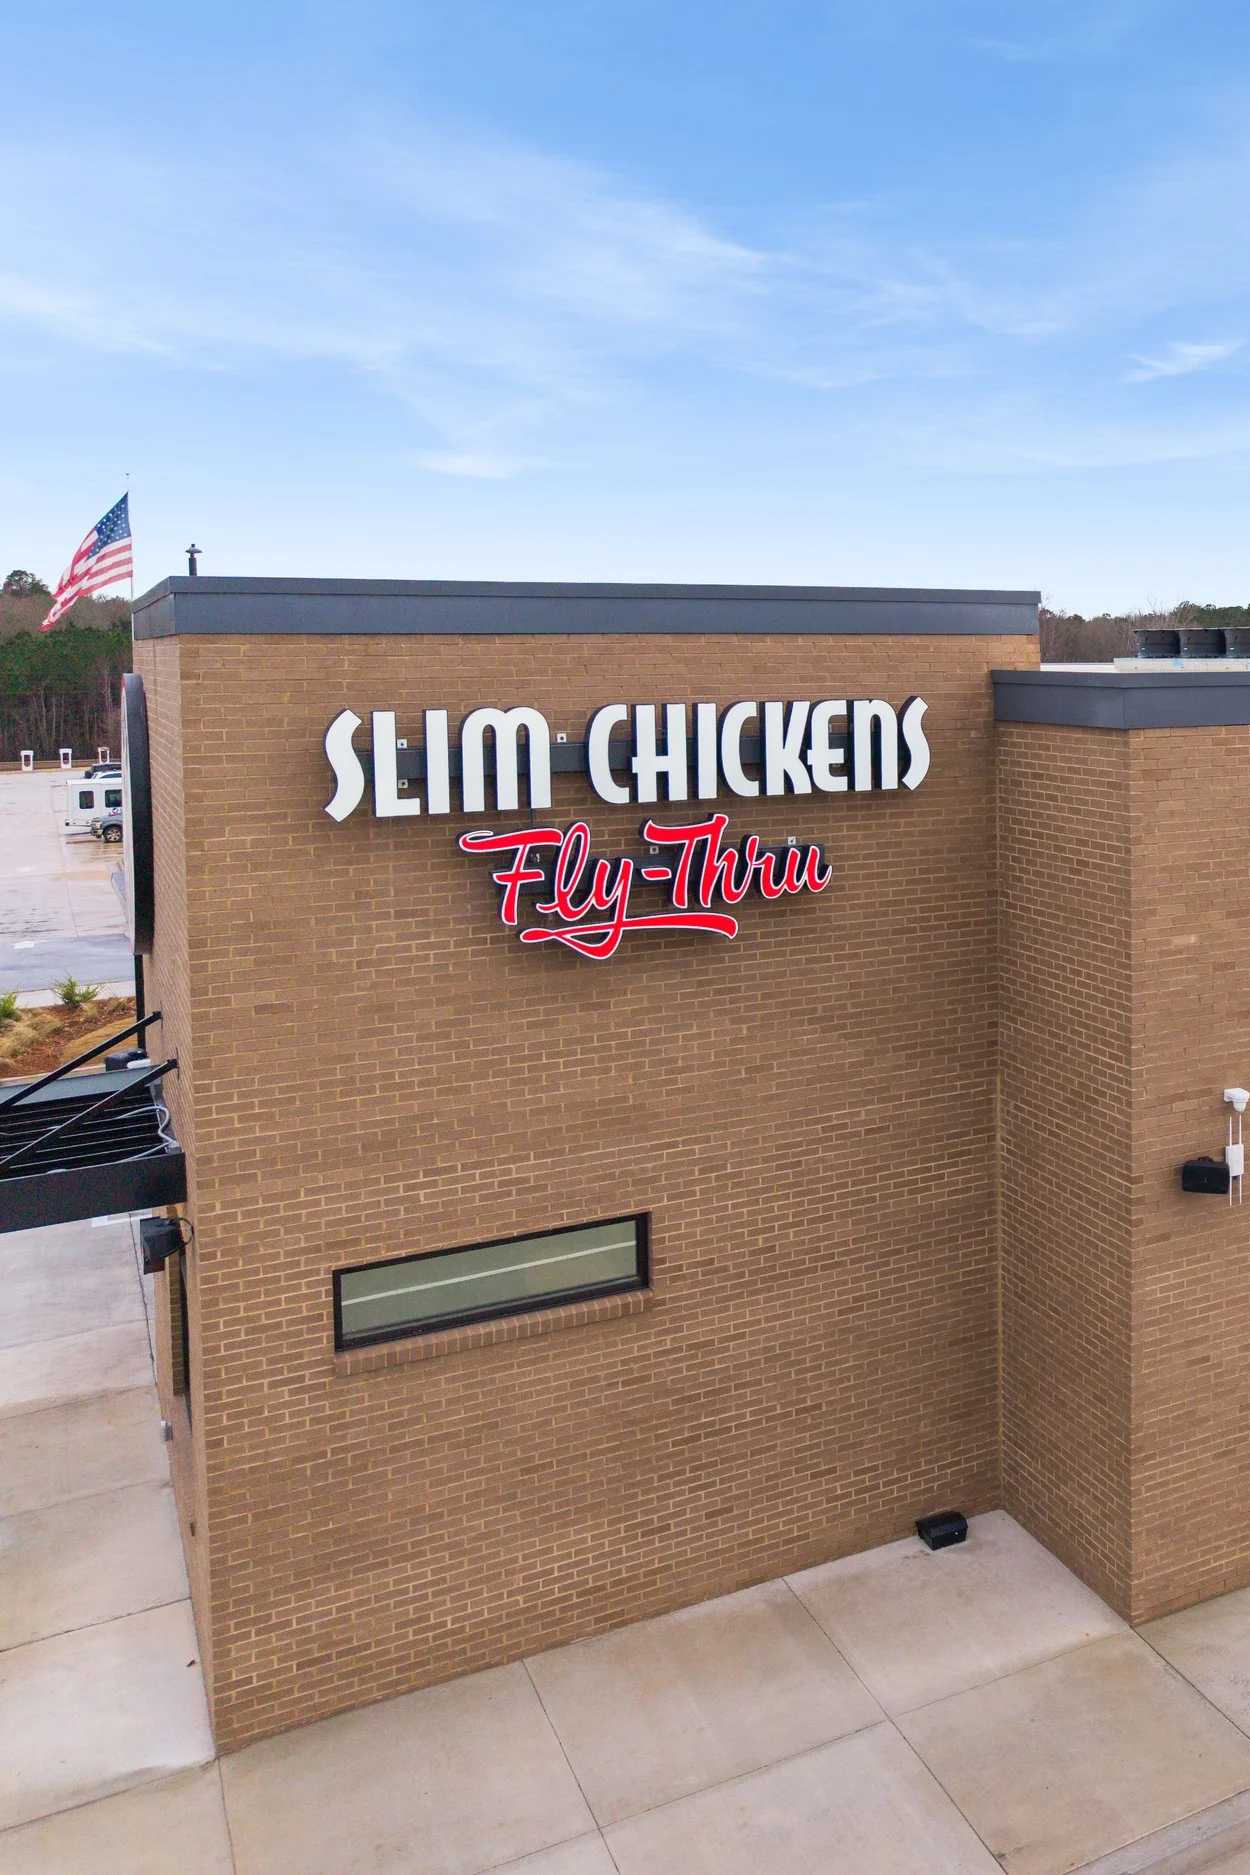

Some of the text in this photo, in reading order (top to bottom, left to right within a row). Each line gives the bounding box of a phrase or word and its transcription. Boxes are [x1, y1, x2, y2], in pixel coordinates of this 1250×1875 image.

[324, 695, 931, 822] SLIM CHICKENS
[458, 812, 833, 960] Fly-Thru
